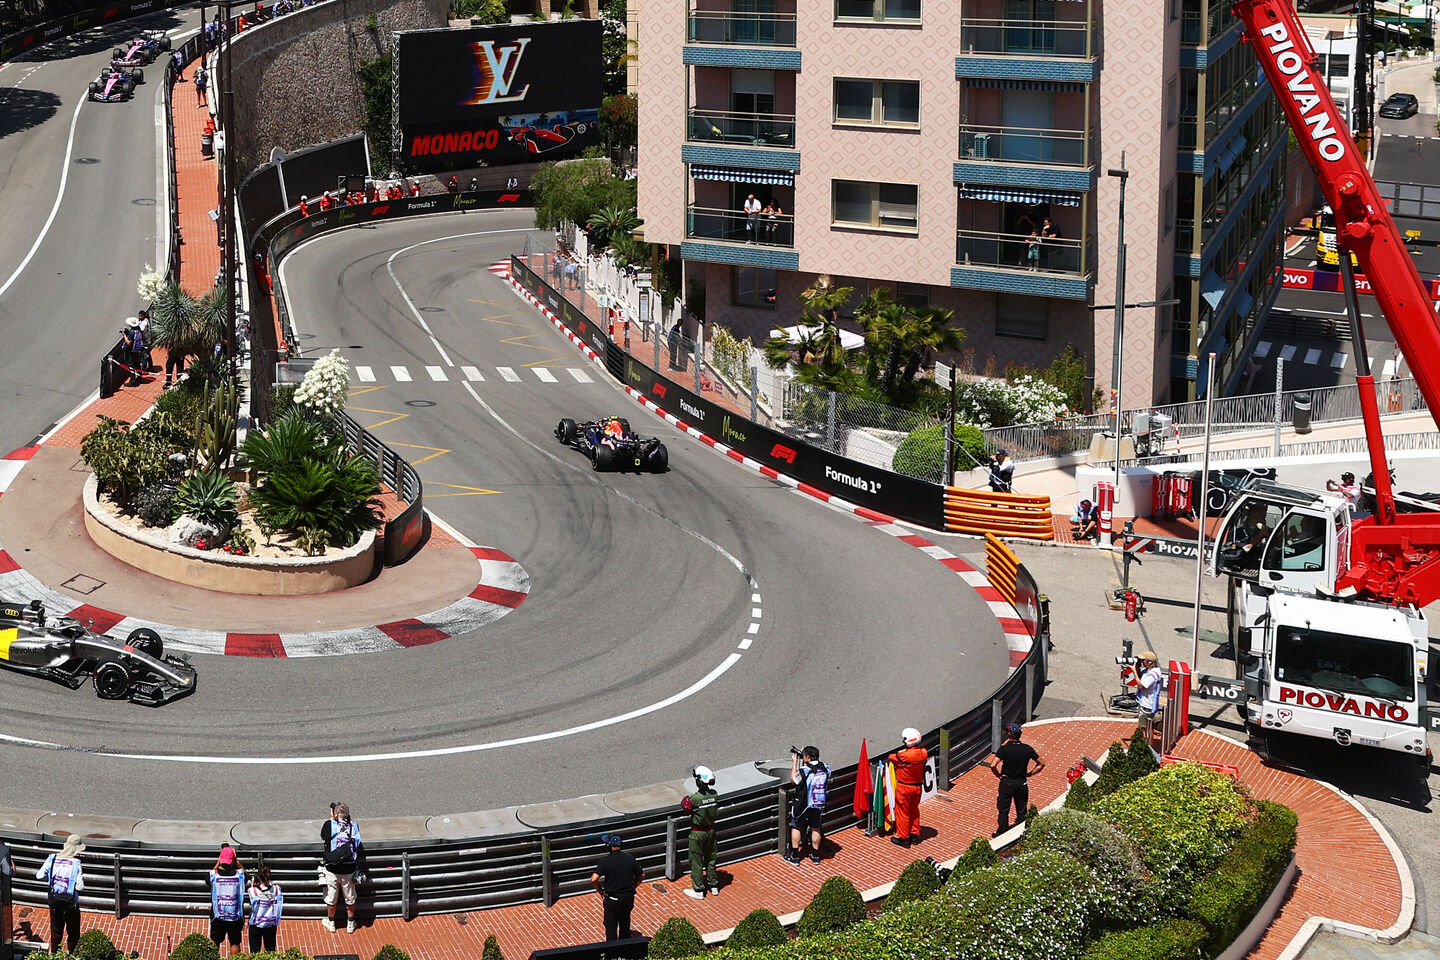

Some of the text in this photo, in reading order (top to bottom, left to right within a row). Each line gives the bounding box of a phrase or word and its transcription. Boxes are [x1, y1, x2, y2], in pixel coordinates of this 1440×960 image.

[1261, 21, 1345, 161] PIOVANO
[411, 129, 500, 157] MONACO
[408, 201, 431, 210] Formula
[680, 398, 700, 420] Formula
[770, 443, 798, 464] F1
[825, 465, 868, 491] Formula
[1156, 541, 1214, 558] PIOVAN
[10, 646, 38, 655] Revolut
[1279, 686, 1409, 721] PIOVANO
